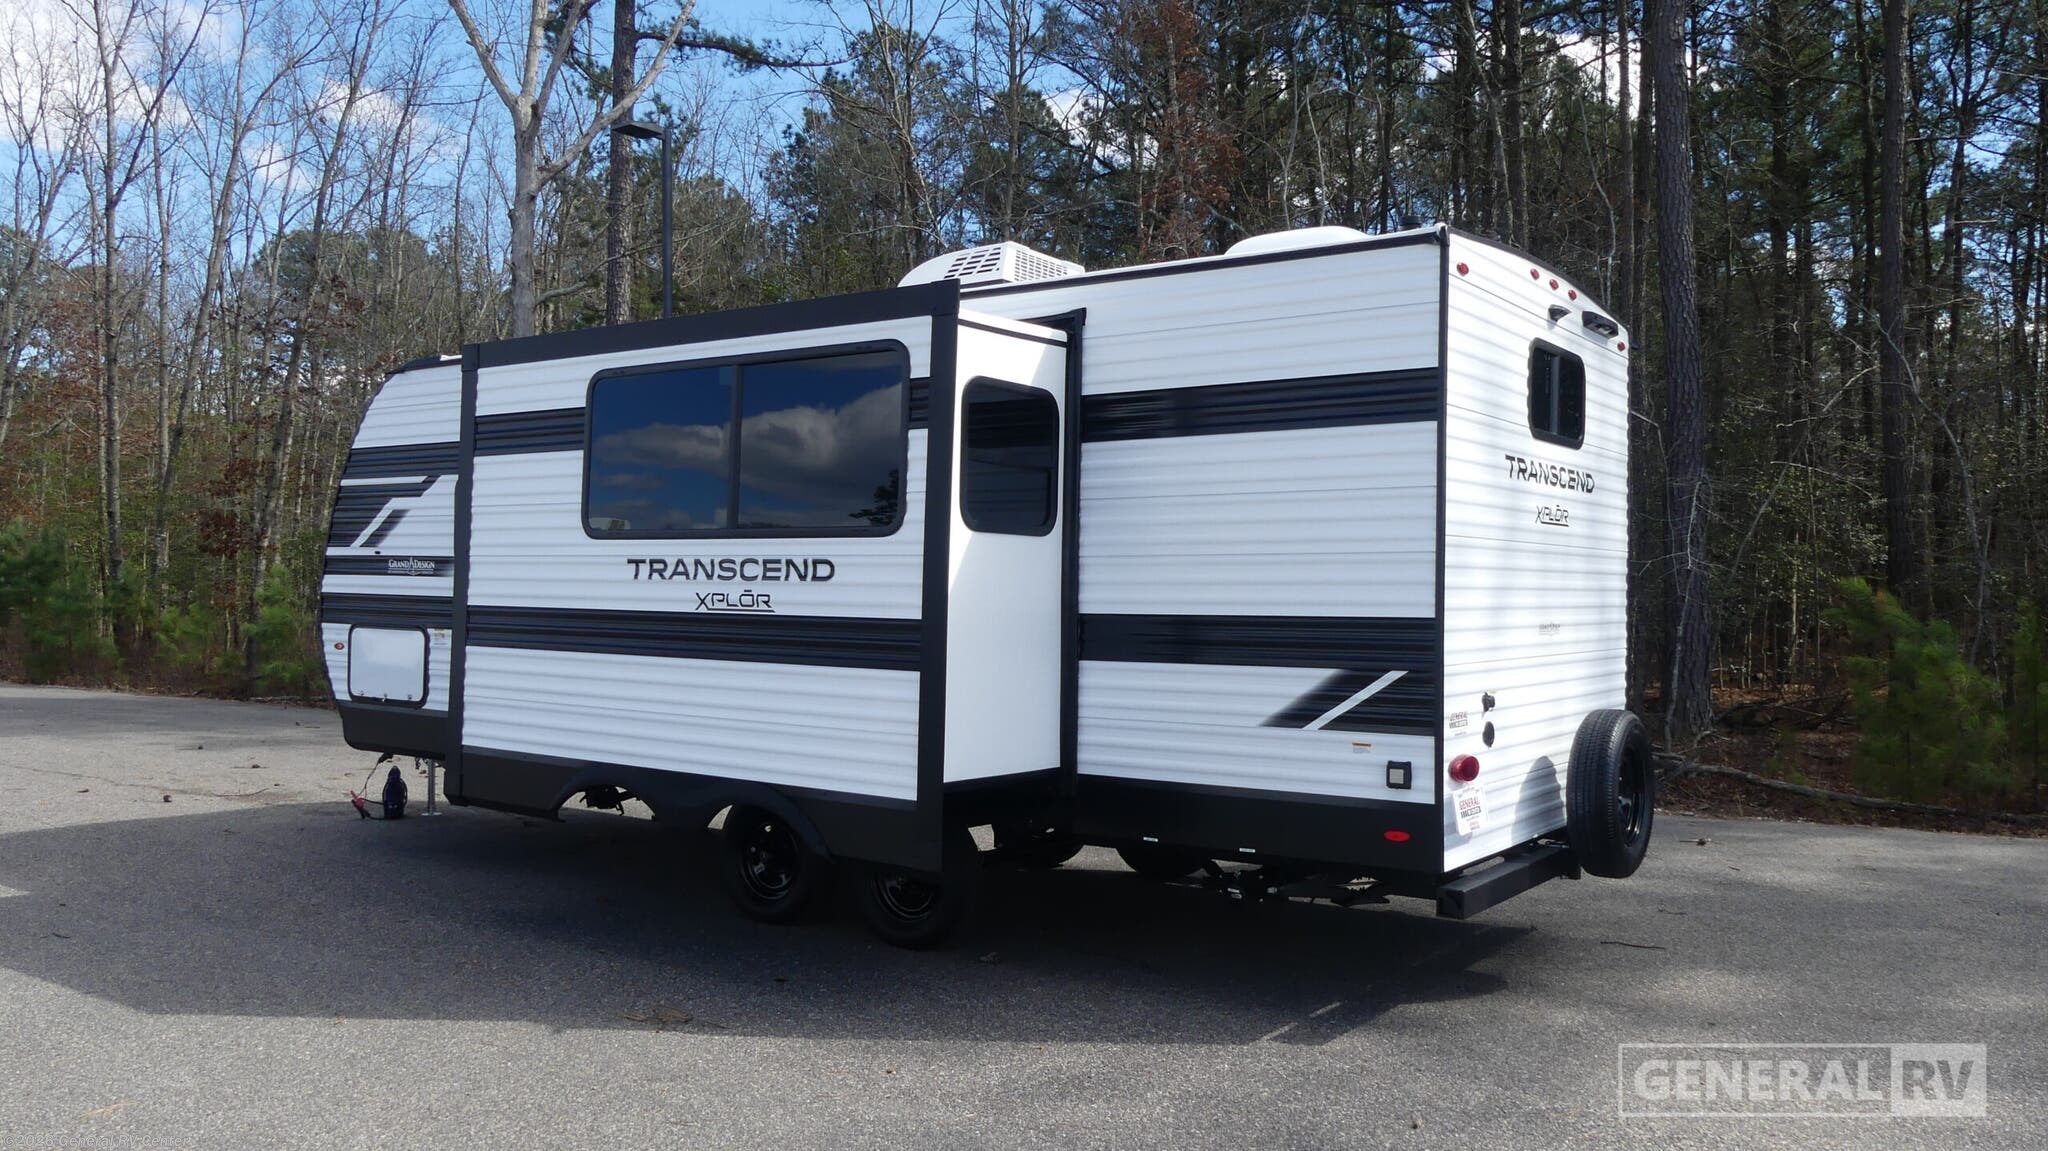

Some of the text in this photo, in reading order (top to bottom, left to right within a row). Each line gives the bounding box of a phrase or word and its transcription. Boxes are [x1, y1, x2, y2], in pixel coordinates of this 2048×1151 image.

[1505, 454, 1594, 493] TRANSCEND
[388, 559, 435, 569] GRAND DESIGN
[627, 558, 836, 582] TRANSCEND
